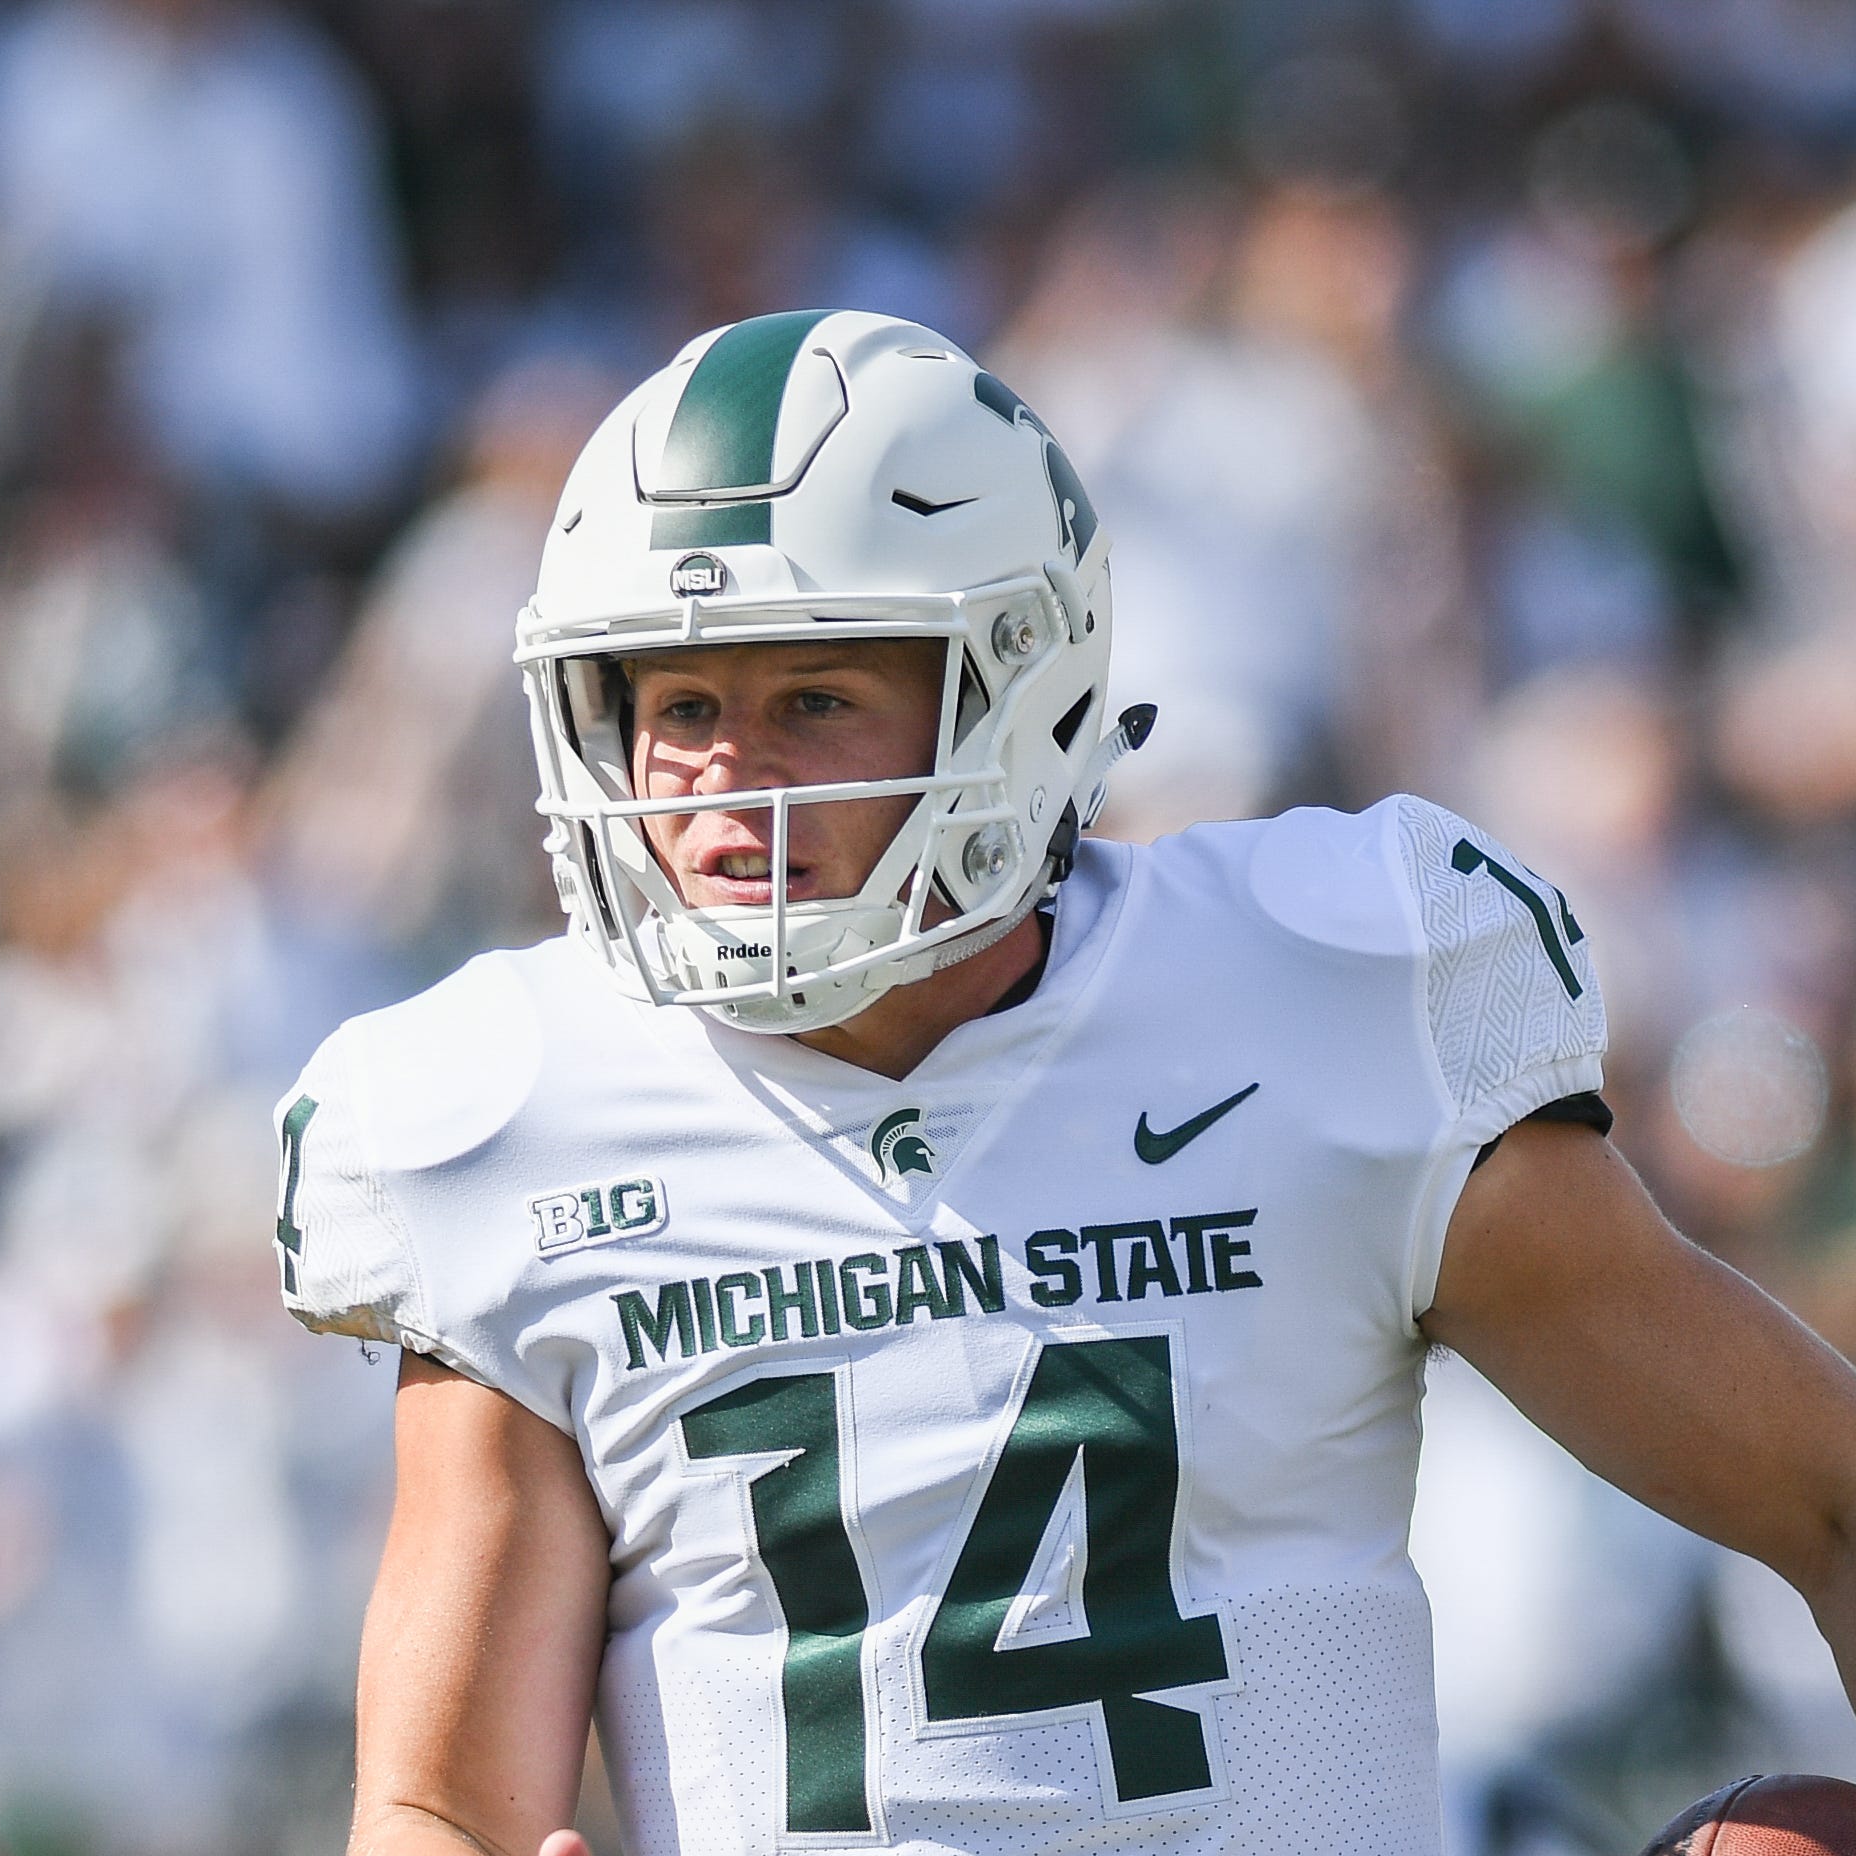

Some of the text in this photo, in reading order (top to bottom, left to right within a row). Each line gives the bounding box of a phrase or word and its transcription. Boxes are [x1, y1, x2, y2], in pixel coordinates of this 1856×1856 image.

[672, 567, 723, 592] MSU
[716, 942, 773, 961] Ridde
[609, 1207, 1264, 1371] MICHIGAN STATE
[678, 1332, 1232, 1836] 14
